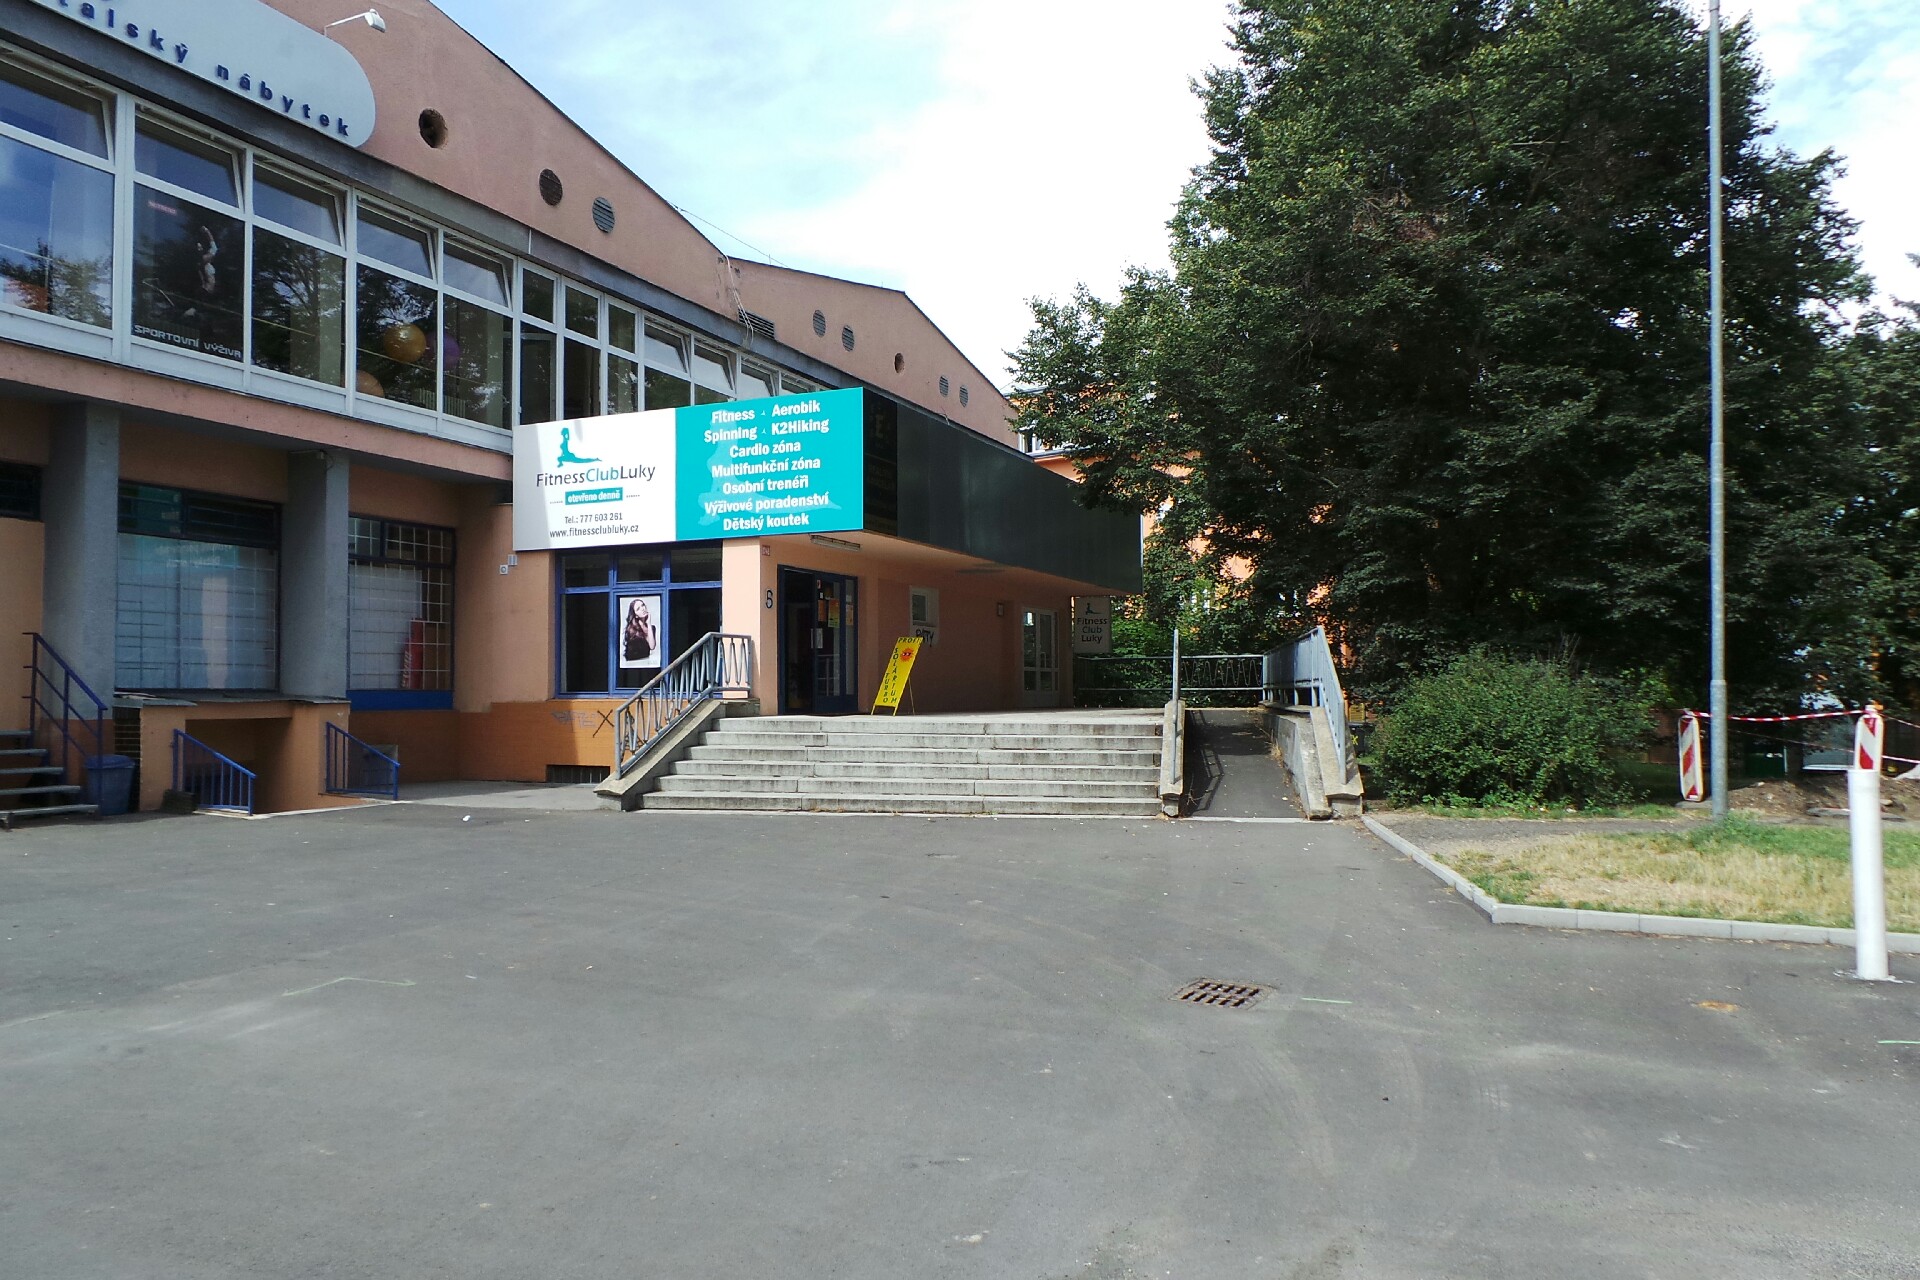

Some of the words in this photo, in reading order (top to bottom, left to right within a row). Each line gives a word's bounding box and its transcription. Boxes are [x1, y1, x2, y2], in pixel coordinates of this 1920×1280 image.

[216, 64, 349, 137] nábytek
[134, 325, 199, 347] SPORTOVNÍ
[711, 409, 755, 423] Fitness
[771, 400, 820, 417] Aerobik
[704, 426, 757, 444] Spinning
[771, 418, 829, 436] K2Hiking
[729, 443, 770, 458] Cardio
[772, 440, 801, 454] zóna
[712, 459, 789, 477] Multifunkční
[791, 456, 821, 470] zóna
[722, 478, 764, 494] Osobní
[767, 475, 809, 490] trenéři
[567, 493, 597, 503] otevřeno
[598, 490, 621, 501] denně
[704, 498, 753, 516] Výživové
[755, 491, 829, 512] poradenství
[565, 516, 579, 524] Tel.:
[580, 514, 593, 523] 777
[594, 513, 608, 522] 603
[723, 515, 764, 531] Dětský
[766, 512, 809, 528] koutek
[549, 525, 639, 538] www.fitnessclubluky.cz
[1077, 617, 1107, 625] Fitness
[1082, 625, 1102, 634] Club
[1081, 634, 1102, 644] Luky
